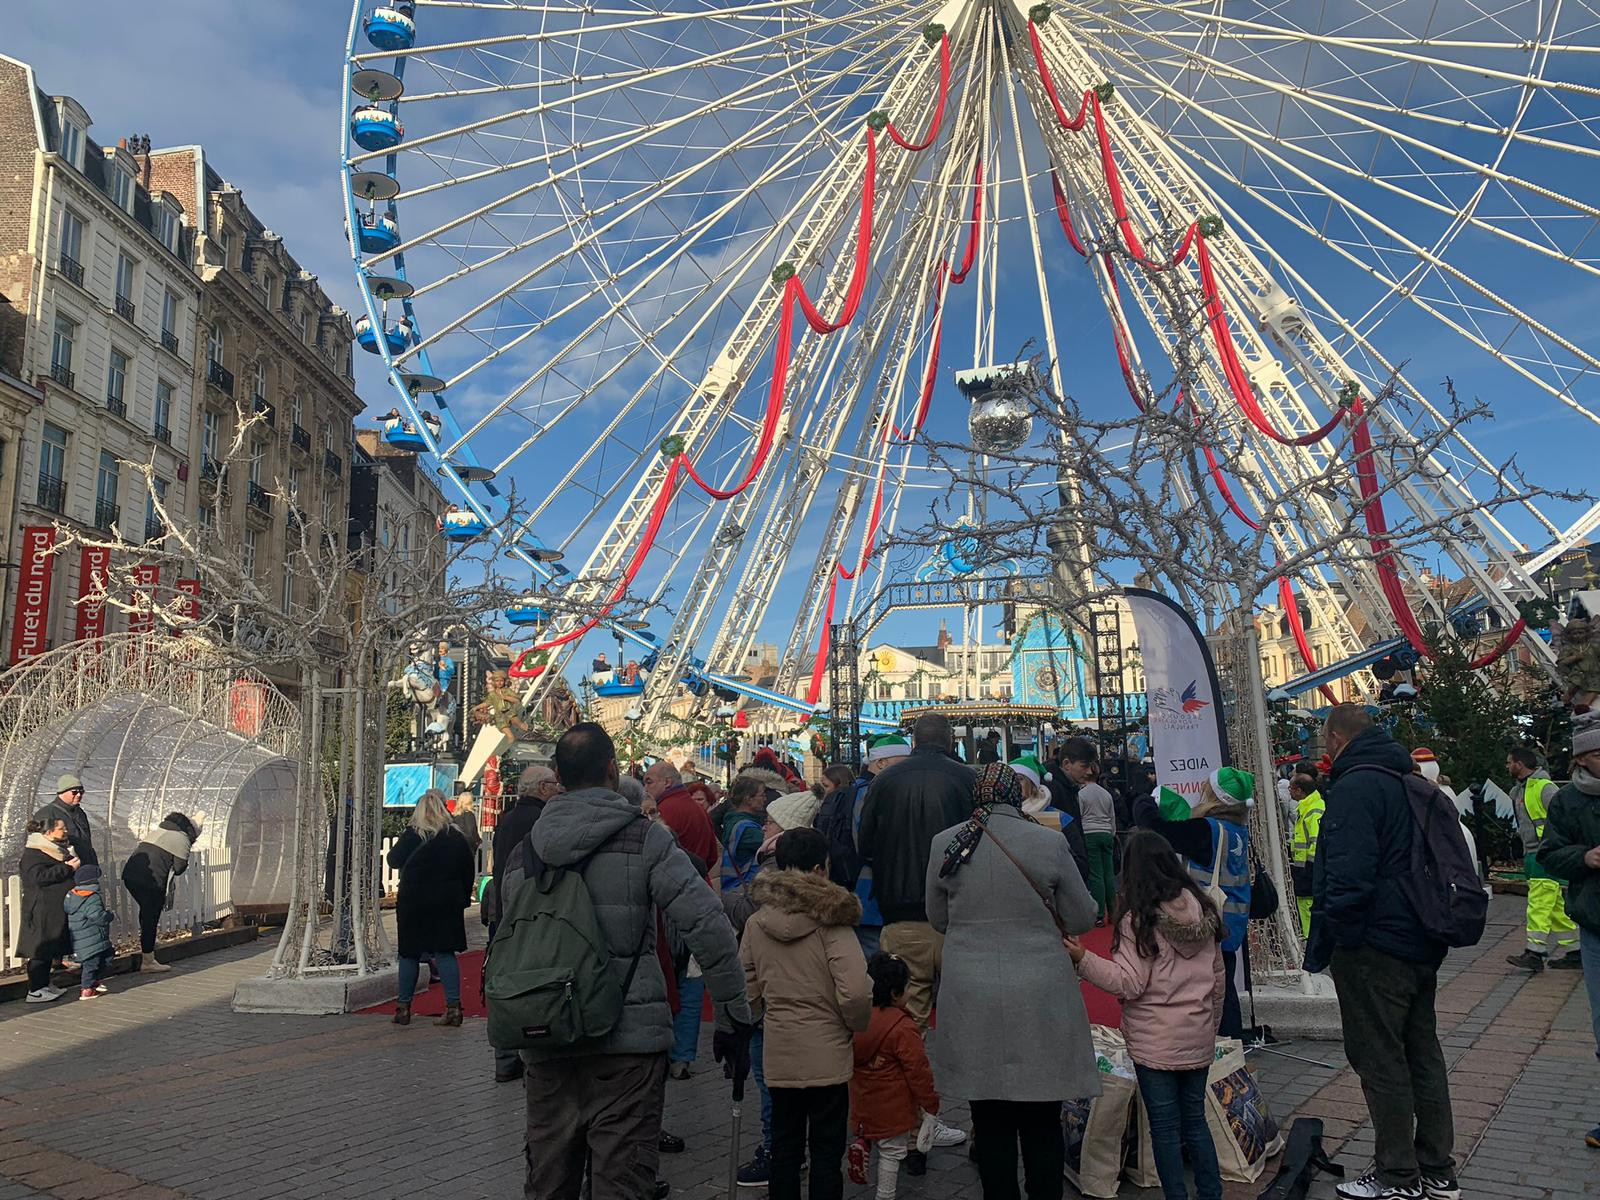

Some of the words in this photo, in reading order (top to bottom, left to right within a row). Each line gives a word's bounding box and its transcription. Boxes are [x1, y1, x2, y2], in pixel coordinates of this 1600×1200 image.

[31, 532, 49, 575] nord
[25, 581, 43, 606] du
[18, 608, 40, 660] Furet
